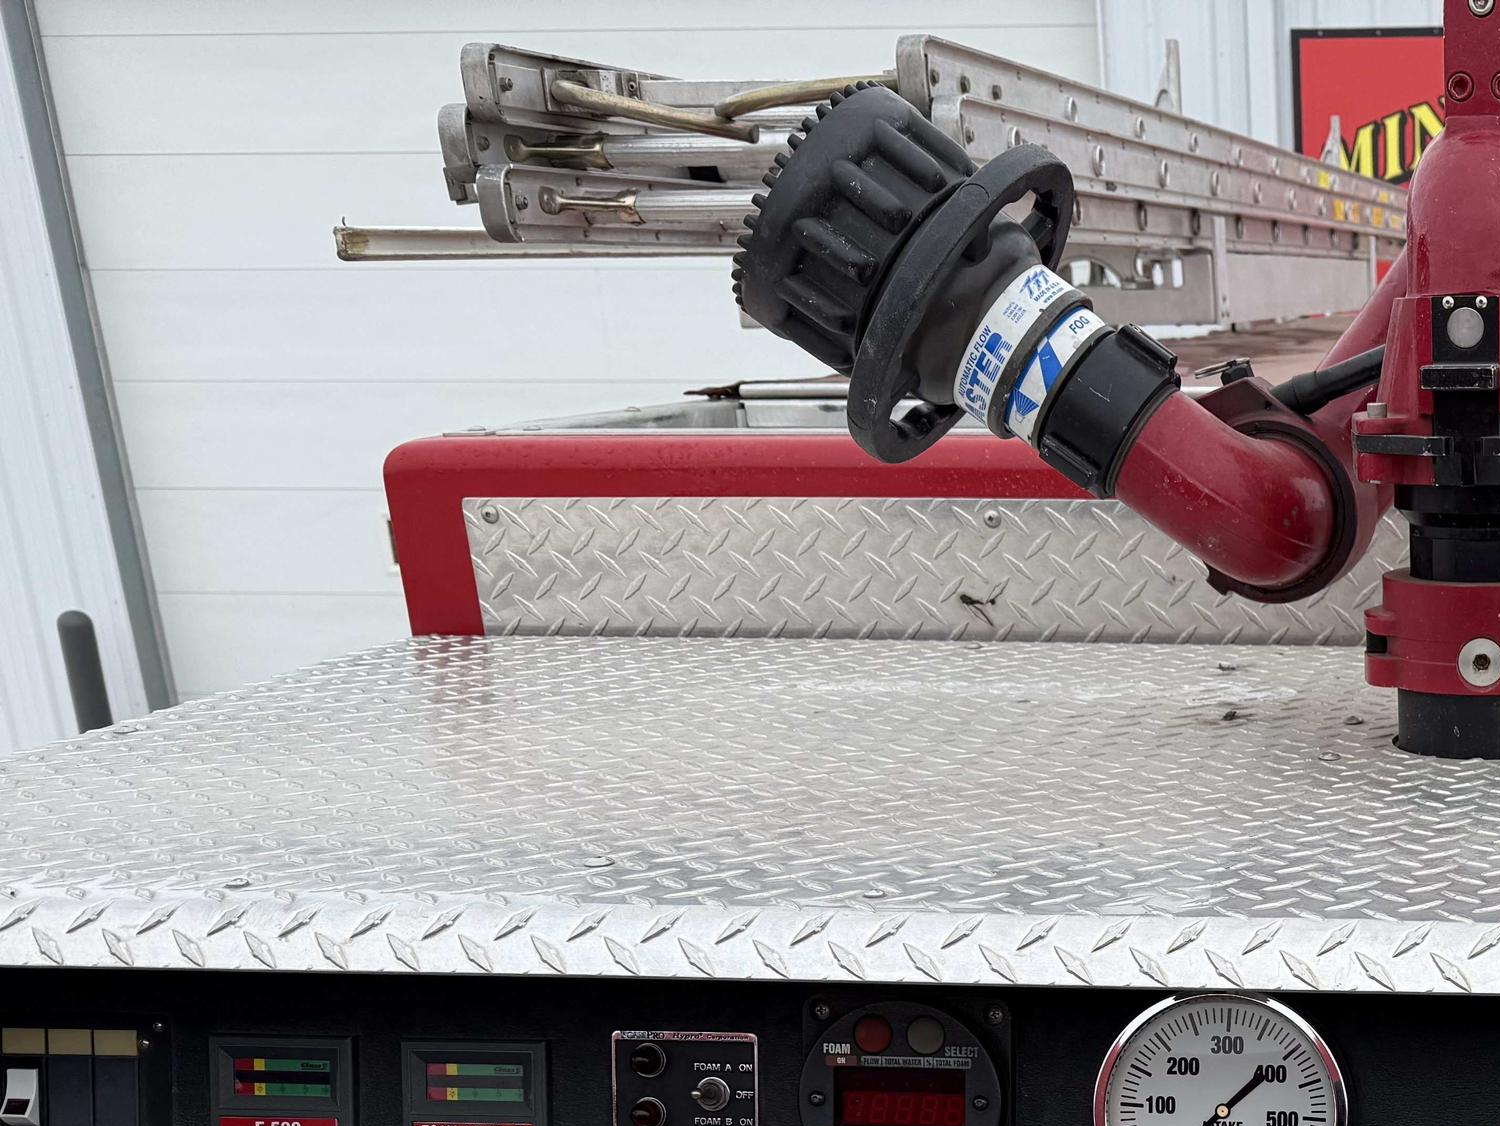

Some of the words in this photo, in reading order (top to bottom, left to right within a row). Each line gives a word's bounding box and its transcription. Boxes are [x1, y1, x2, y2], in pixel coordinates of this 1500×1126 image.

[1069, 316, 1090, 334] FOG
[975, 325, 991, 352] FLOW
[823, 1043, 851, 1054] FOAM
[945, 1046, 979, 1058] SELECT
[1210, 1035, 1244, 1055] 300
[694, 1063, 720, 1071] FOAM
[739, 1064, 753, 1072] ON
[1166, 1057, 1200, 1076] 200
[736, 1091, 753, 1099] OFF
[1145, 1096, 1176, 1115] 100
[695, 1117, 721, 1126] FOAM
[725, 1118, 733, 1126] B
[740, 1118, 753, 1126] ON
